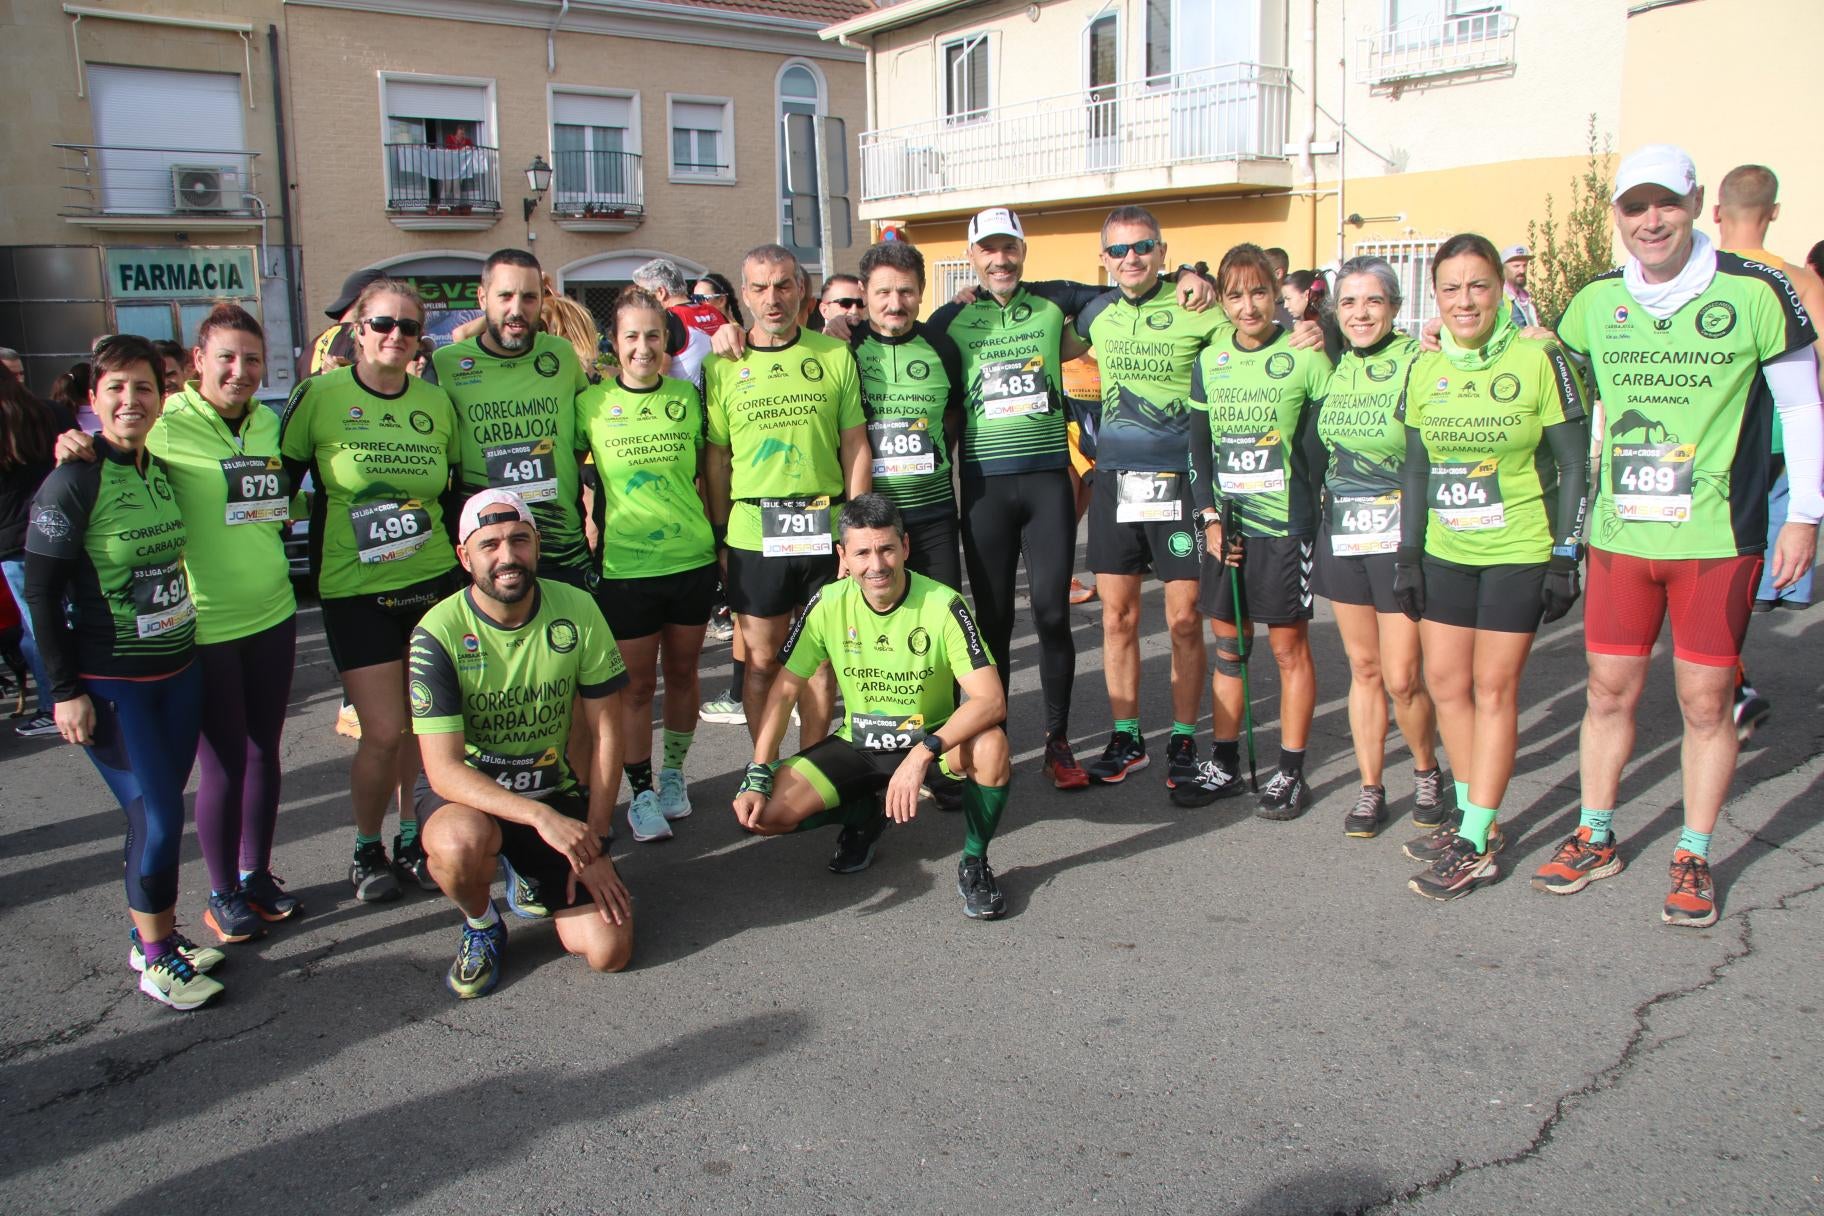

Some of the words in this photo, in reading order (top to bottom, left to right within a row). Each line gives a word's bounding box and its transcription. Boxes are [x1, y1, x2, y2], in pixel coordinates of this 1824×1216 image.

[120, 264, 243, 291] FARMACIA
[1743, 260, 1809, 327] CARBAJOSA
[968, 329, 1045, 349] CORRECAMINOS
[979, 345, 1040, 361] CARBAJOSA
[1105, 339, 1175, 358] CORRECAMINOS
[1106, 356, 1174, 373] CARBAJOSA
[1602, 351, 1736, 366] CORRECAMINOS
[996, 374, 1036, 396] 483
[1108, 372, 1172, 382] SALAMANCA
[1556, 355, 1574, 404] CARBAJOSA
[1612, 373, 1712, 388] CARBAJOSA
[737, 393, 828, 412] CORRECAMINOS
[868, 392, 936, 402] RRECAMINOS
[1210, 388, 1284, 404] CORRECAMINOS
[1627, 394, 1690, 405] SALAMANCA
[468, 396, 559, 423] CORRECAMINOS
[747, 405, 818, 422] CARBAJOSA
[758, 419, 808, 431] SALAMANCA
[1421, 414, 1522, 428] CORRECAMINOS
[474, 418, 558, 444] CARBAJOSA
[1426, 430, 1508, 442] CARBAJOSA
[340, 441, 442, 455] CORRECAMINOS
[605, 432, 691, 448] CORRECAMINOS
[880, 434, 922, 454] 486
[512, 446, 530, 454] CROSS
[616, 443, 688, 458] CARBAJOSA
[1436, 446, 1494, 454] SALAMANCA
[354, 454, 438, 466] CARBAJOSA
[628, 455, 679, 466] SALAMANCA
[1228, 450, 1269, 472] 487
[365, 467, 428, 476] SALAMANCA
[504, 458, 543, 482] 491
[242, 474, 279, 498] 679
[1620, 466, 1675, 492] 489
[1436, 482, 1487, 506] 484
[228, 507, 288, 520] JOMISAGA
[360, 508, 374, 517] LIGA
[378, 503, 399, 512] CROSS
[370, 514, 418, 542] 496
[778, 514, 814, 533] 791
[1342, 509, 1388, 532] 485
[766, 542, 830, 552] JOMISAGA
[144, 567, 162, 577] LIGA
[152, 574, 187, 606] 492
[843, 666, 934, 682] CORRECAMINOS
[468, 674, 572, 712] CORRECAMINOS
[856, 680, 924, 695] CARBAJOSA
[864, 694, 916, 705] SALAMANCA
[469, 700, 566, 732] CARBAJOSA
[474, 722, 562, 745] SALAMANCA
[865, 732, 912, 750] 482
[490, 756, 506, 764] LIGA
[496, 770, 542, 790] 481
